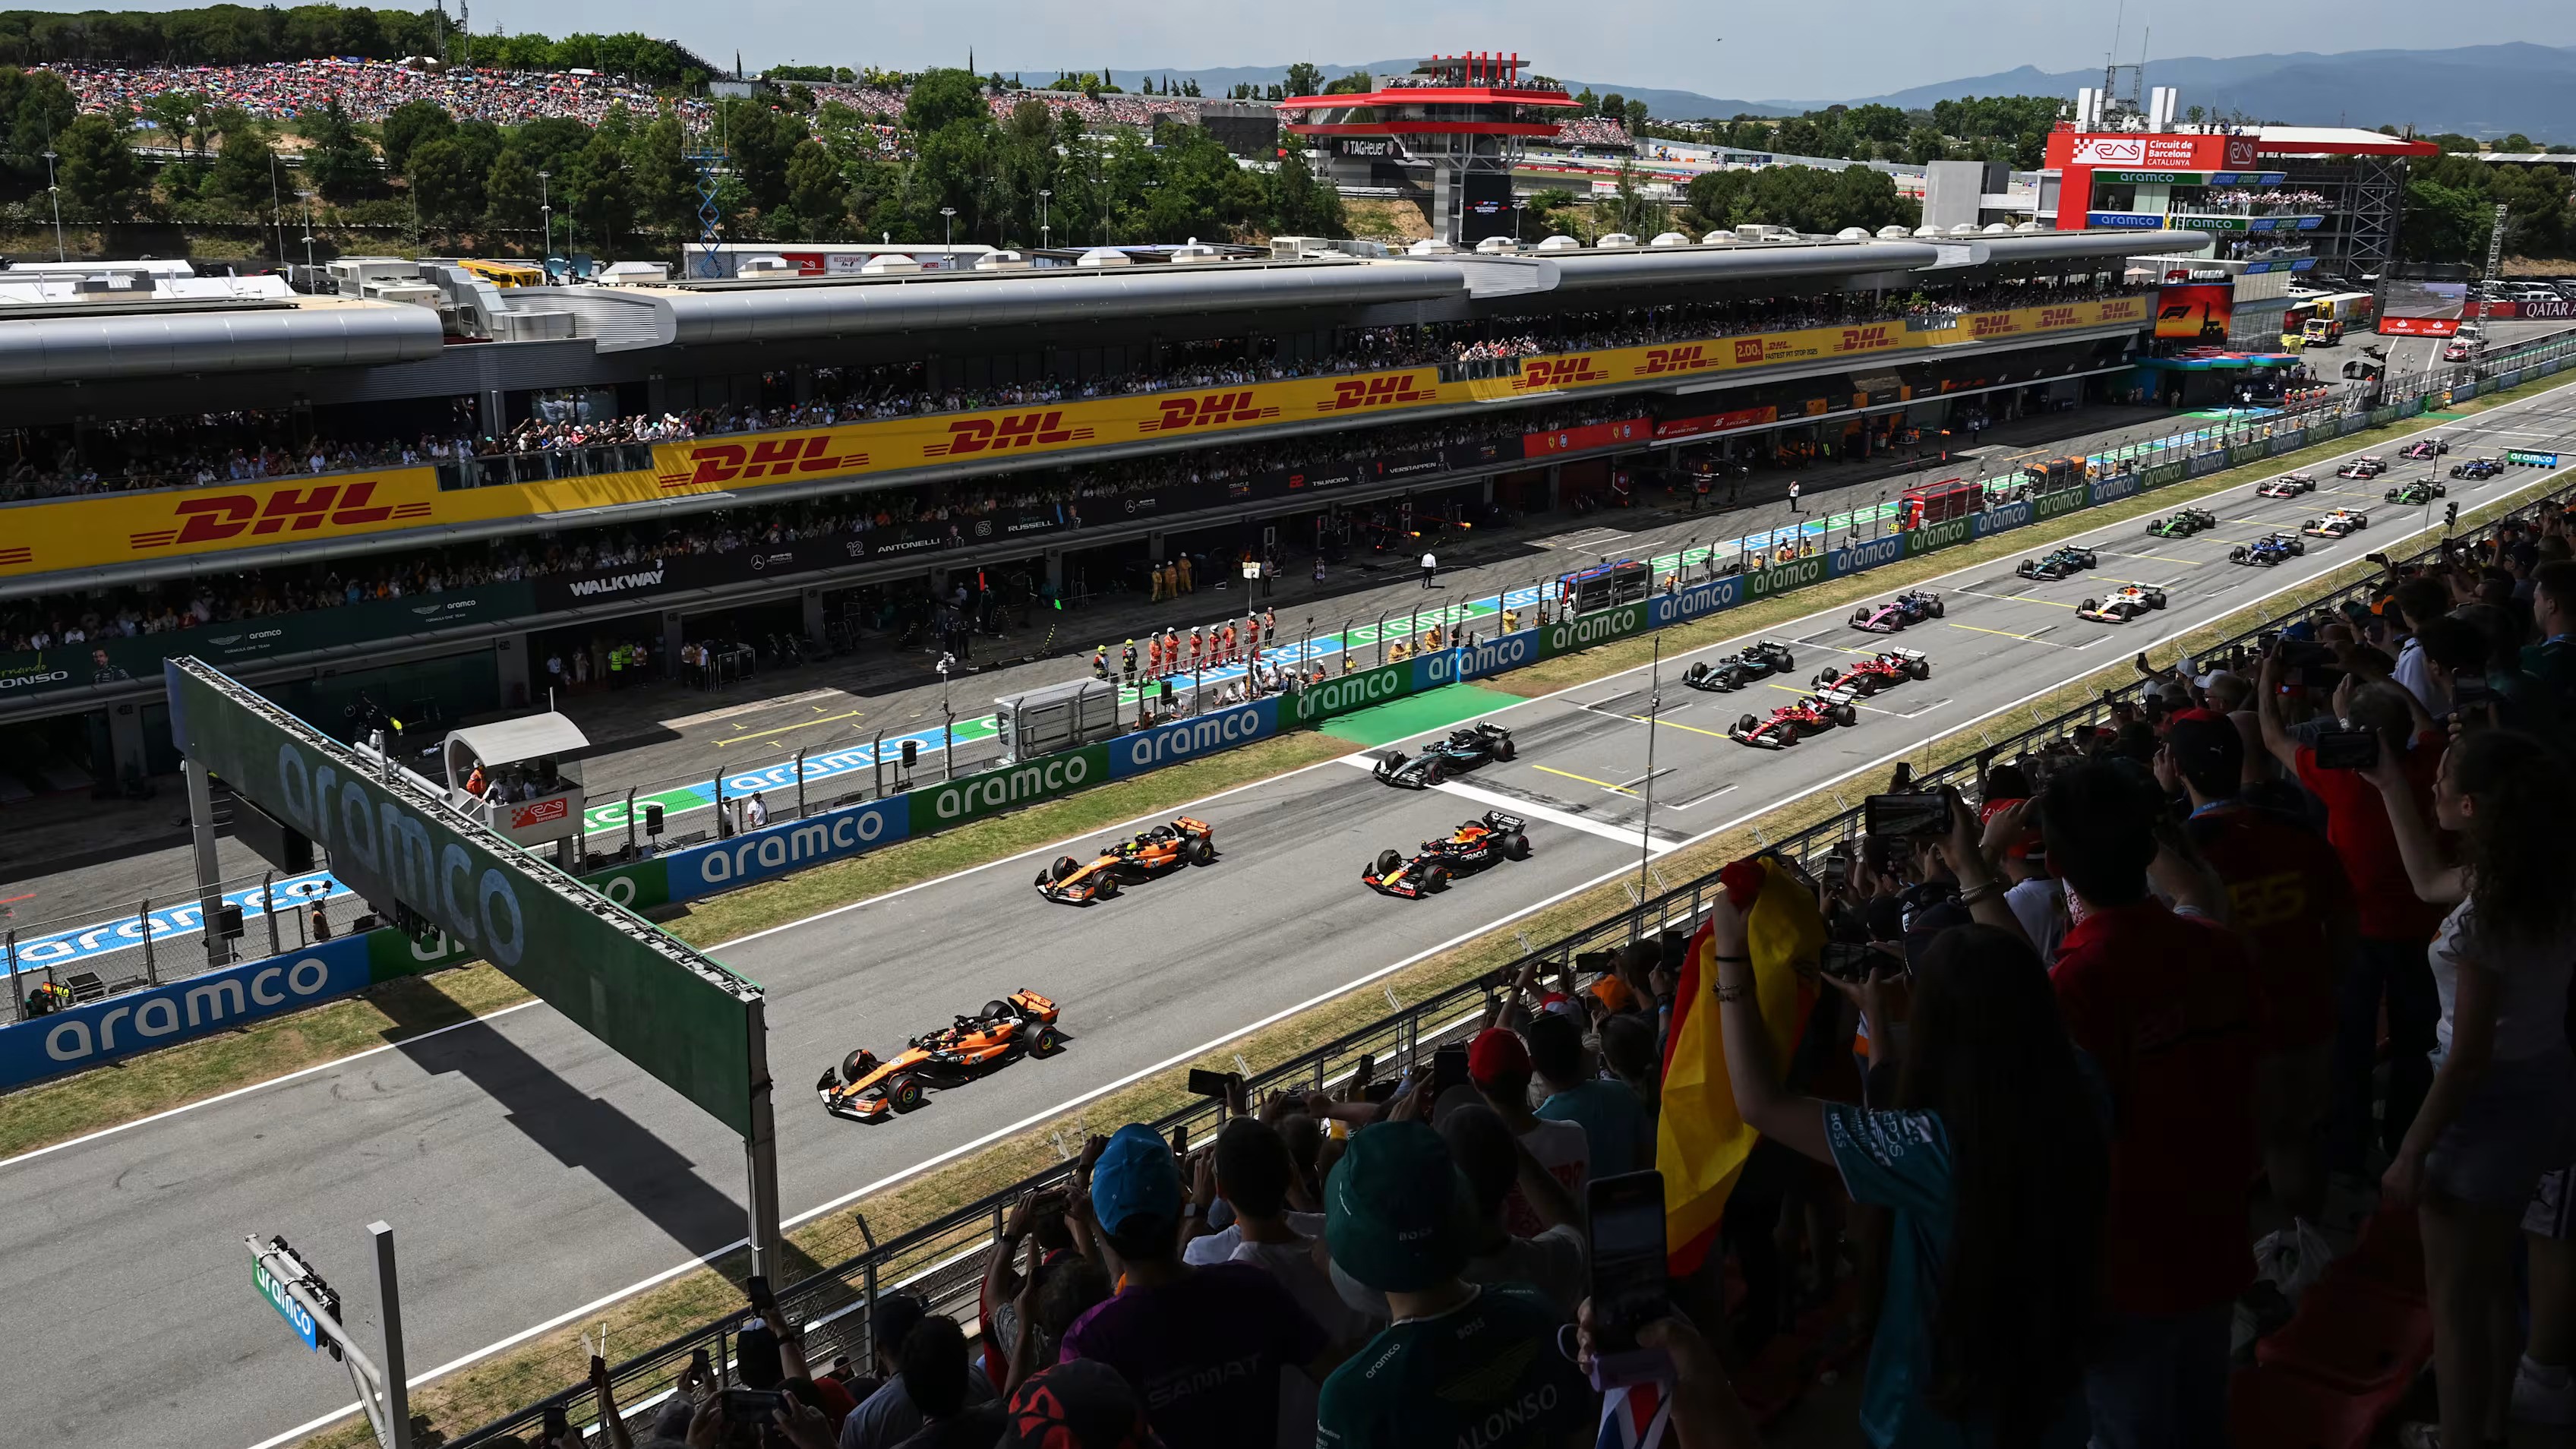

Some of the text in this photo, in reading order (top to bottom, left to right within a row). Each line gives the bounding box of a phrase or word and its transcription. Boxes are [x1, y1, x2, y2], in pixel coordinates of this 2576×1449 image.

[2148, 150, 2191, 158] Barcelona
[2150, 140, 2192, 150] Circuit de
[2120, 172, 2175, 182] aramco
[2101, 216, 2155, 226] aramco
[2177, 218, 2233, 229] aramco
[2041, 307, 2077, 328] DHL
[2101, 301, 2134, 320] DHL
[2527, 302, 2568, 317] QATAR
[1975, 314, 2015, 336] DHL
[1769, 341, 1788, 350] DHL
[1842, 327, 1889, 350] DHL
[1646, 346, 1707, 374] DHL
[1737, 344, 1761, 358] 2.00s
[1766, 352, 1785, 360] FASTEST
[1526, 357, 1596, 387] DHL
[1334, 375, 1421, 410] DHL
[1159, 392, 1261, 430] DHL
[948, 411, 1072, 455] DHL
[2271, 432, 2300, 453] aramco
[2307, 423, 2334, 443] aramco
[690, 436, 844, 485] DHL
[2191, 453, 2224, 474] aramco
[2233, 442, 2264, 462] aramco
[2511, 451, 2552, 463] aramco
[1389, 462, 1437, 474] VERSTAPPEN
[2145, 464, 2181, 487] aramco
[1312, 477, 1349, 487] TSUNODA
[2095, 476, 2134, 500] aramco
[175, 481, 393, 544] DHL
[2040, 491, 2082, 516] aramco
[1008, 520, 1054, 532] RUSSELL
[1979, 504, 2027, 532] aramco
[846, 538, 940, 557] 12 ANTONELLI
[1911, 521, 1964, 551] aramco
[1837, 539, 1896, 572] aramco
[570, 570, 665, 597] WALKWAY
[1754, 560, 1819, 595] aramco
[447, 599, 477, 610] aramco
[1659, 582, 1732, 621] aramco
[249, 629, 282, 639] aramco
[1552, 608, 1636, 649] aramco
[1428, 639, 1525, 680] aramco
[1296, 669, 1398, 719] aramco
[1132, 709, 1259, 765] aramco
[730, 737, 928, 791] aramco
[936, 756, 1088, 819] aramco
[536, 812, 563, 823] Barcelona
[279, 743, 524, 966] aramco
[702, 810, 883, 884] aramco
[1460, 848, 1488, 861] ORACLE
[46, 958, 328, 1062] aramco
[1830, 1112, 1847, 1148] BOSS
[1366, 1343, 1401, 1380] aramco
[1456, 1382, 1558, 1449] ALONSO
